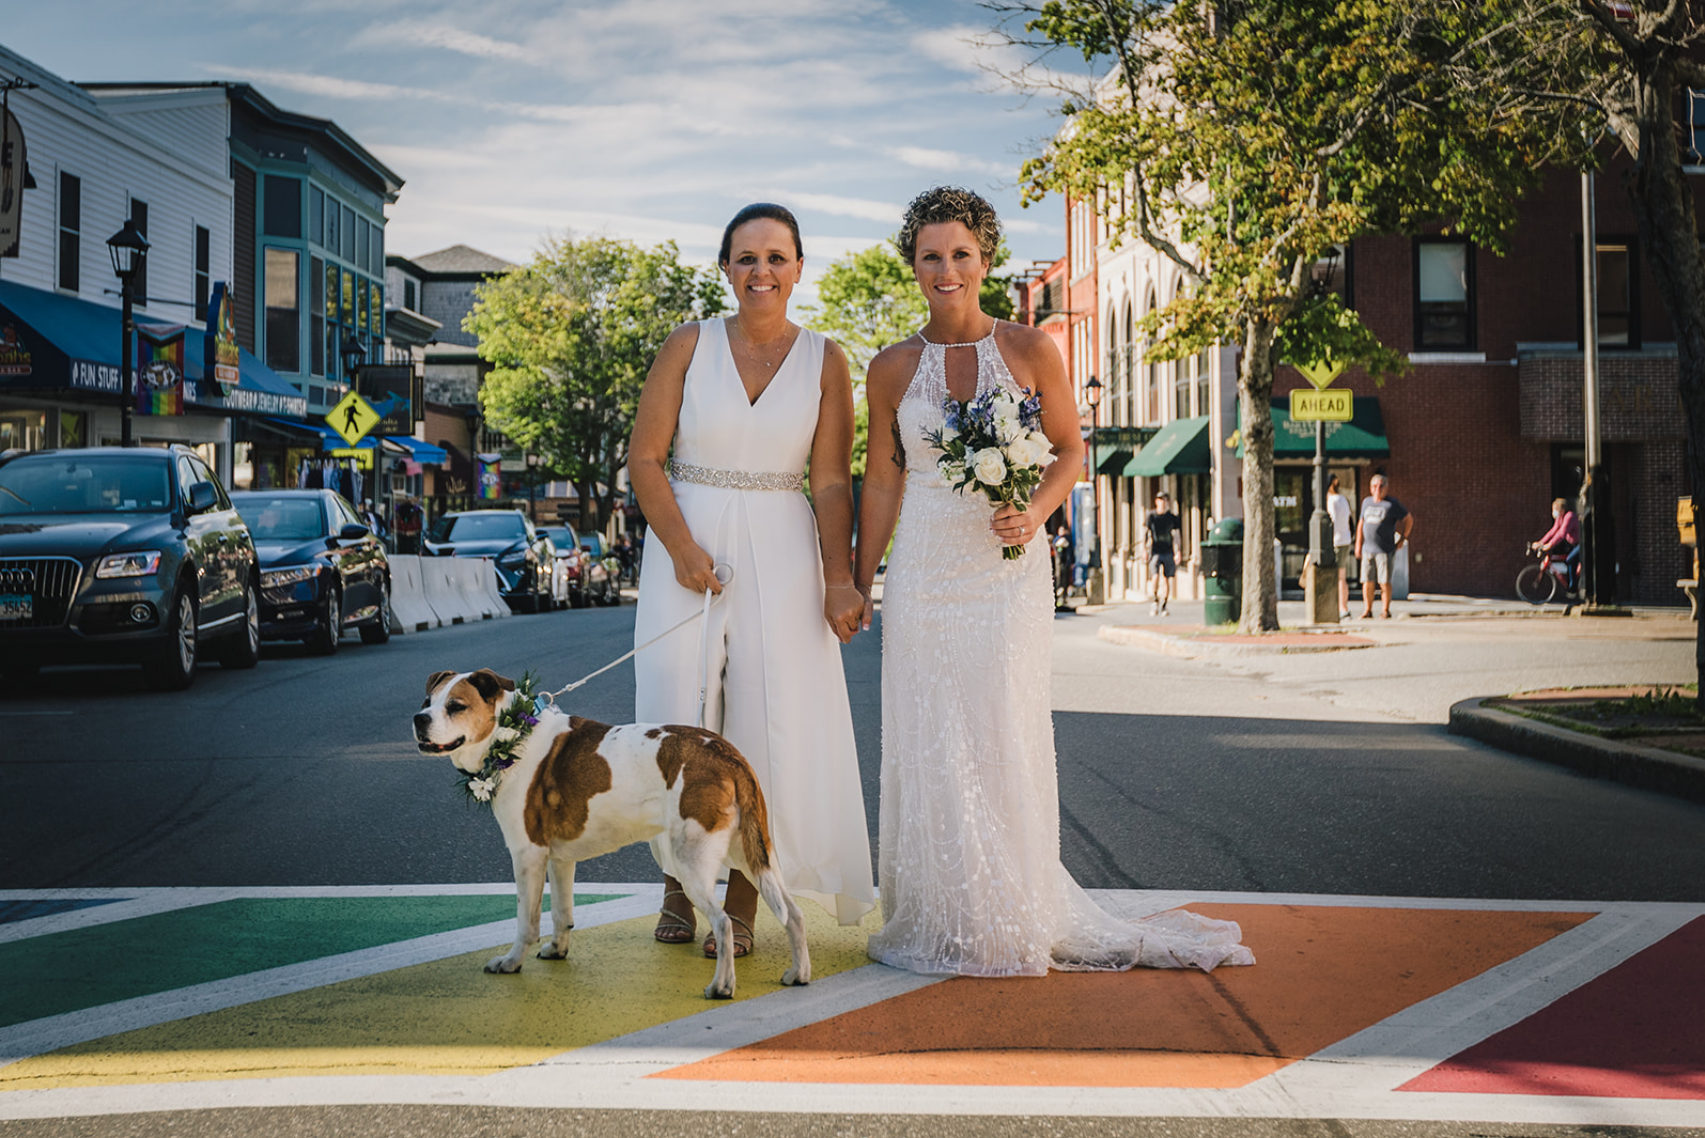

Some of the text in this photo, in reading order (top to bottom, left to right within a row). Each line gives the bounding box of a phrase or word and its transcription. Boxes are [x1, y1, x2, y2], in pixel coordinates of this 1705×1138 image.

[80, 362, 96, 387] FUN
[97, 365, 119, 391] STUFF
[257, 392, 279, 412] JEWELRY
[1300, 399, 1344, 412] AHEAD
